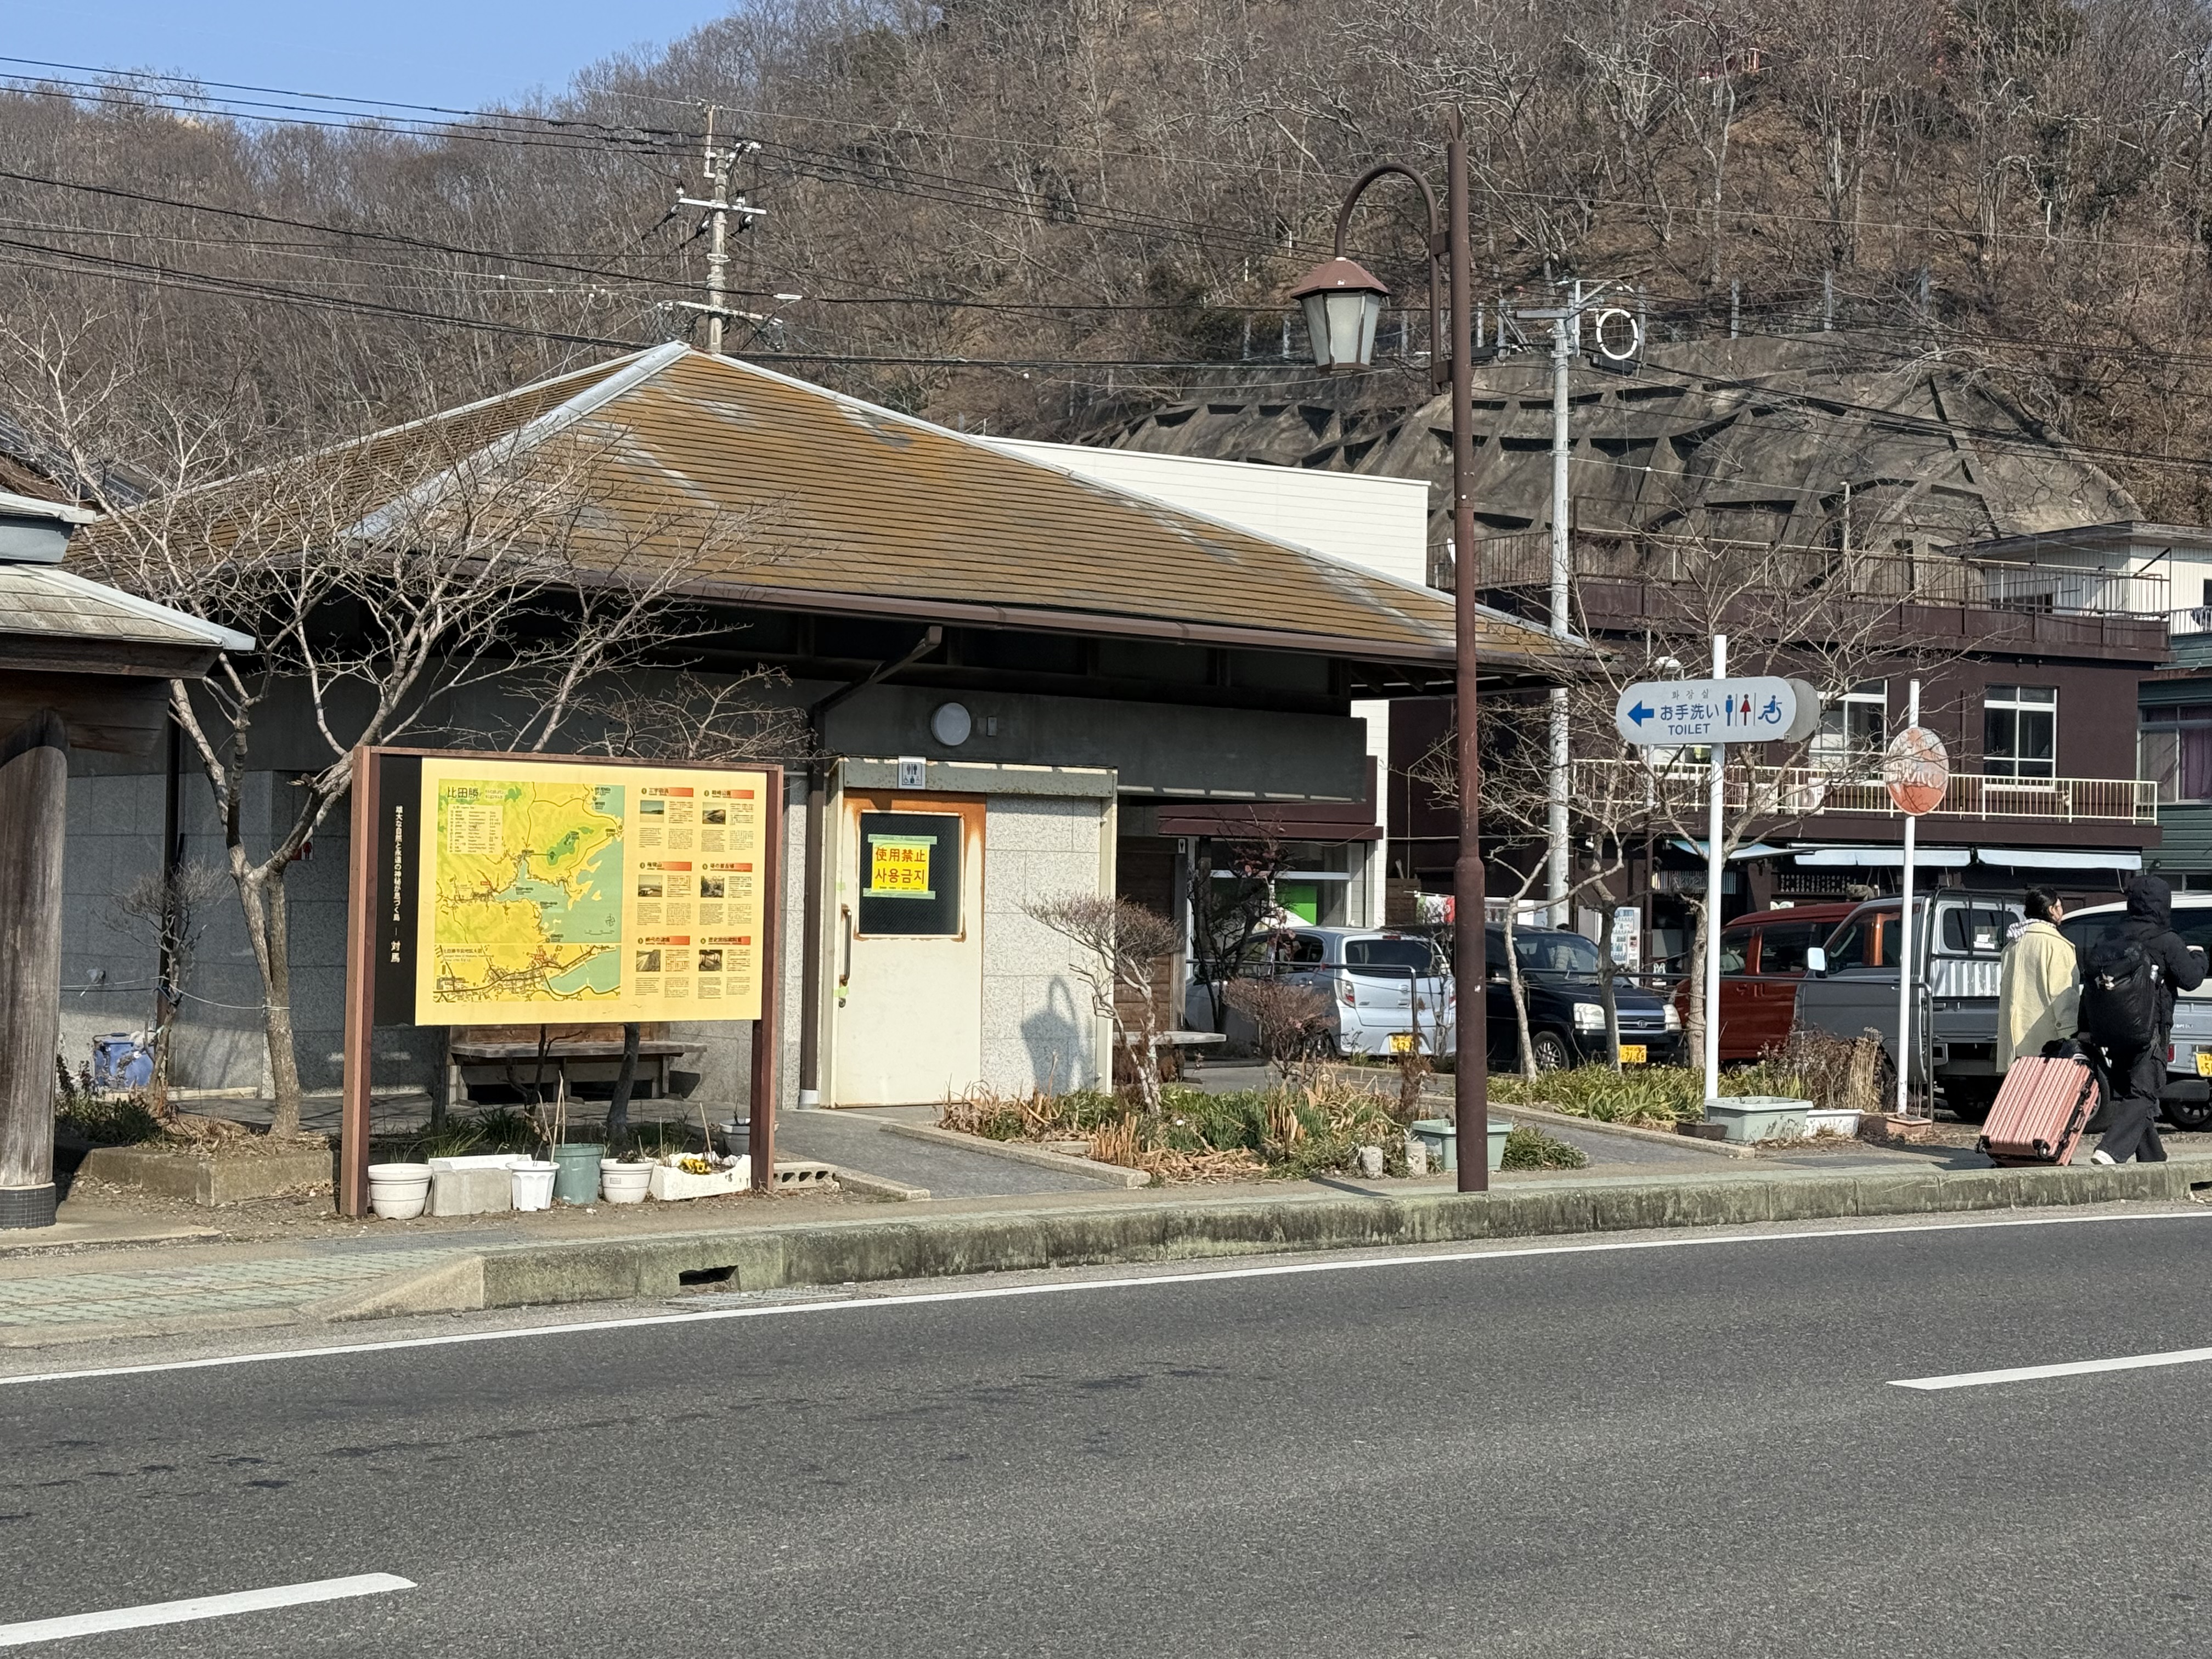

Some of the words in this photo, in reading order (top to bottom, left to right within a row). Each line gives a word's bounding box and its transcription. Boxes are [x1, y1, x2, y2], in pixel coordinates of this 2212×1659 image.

[1660, 703, 1719, 721] お手洗い
[1668, 723, 1711, 736] TOILET
[447, 786, 479, 799] 比田勝
[875, 847, 927, 862] 使用禁止
[874, 867, 926, 885] 사용금지
